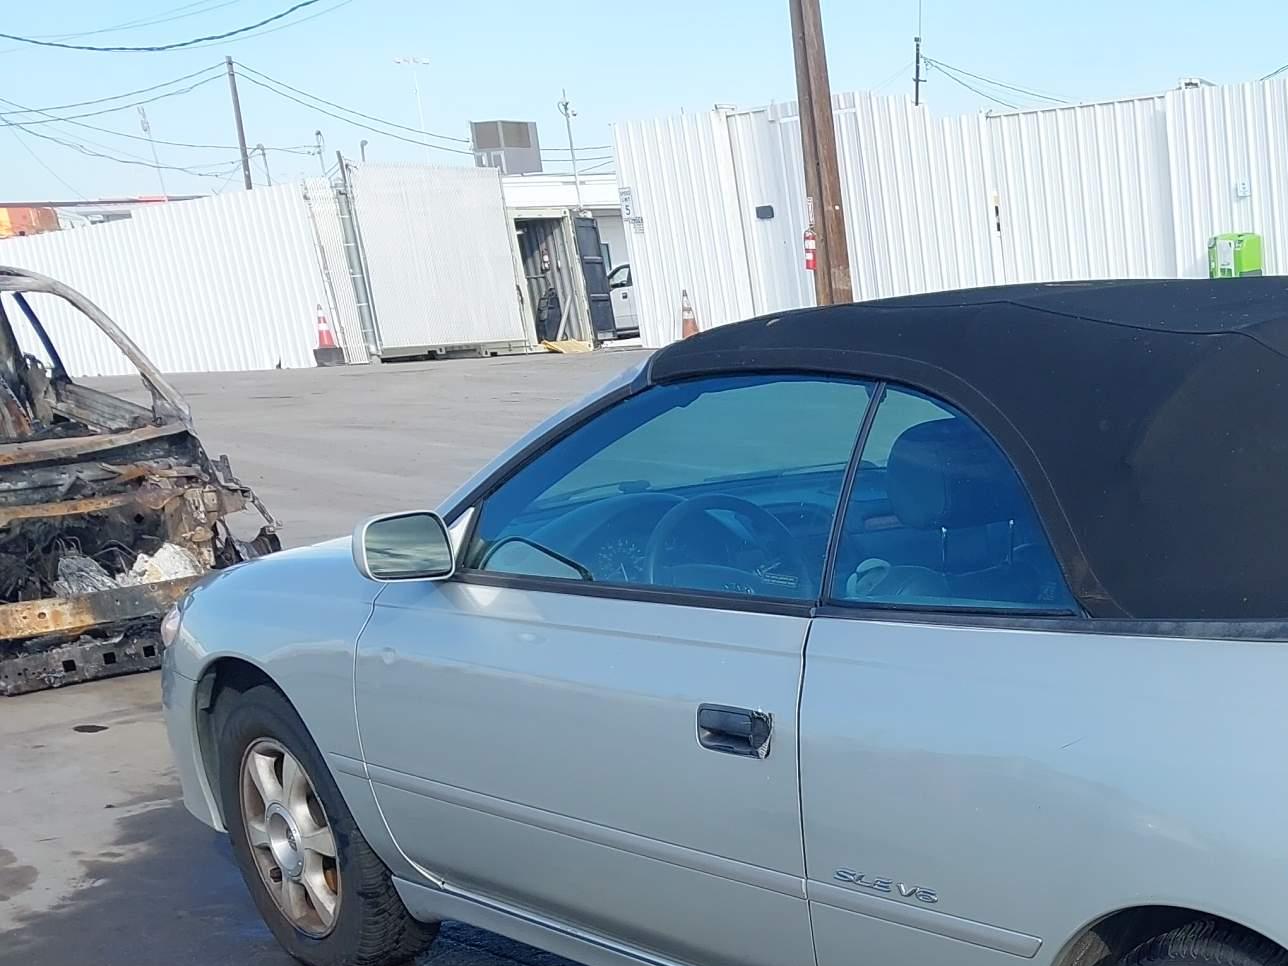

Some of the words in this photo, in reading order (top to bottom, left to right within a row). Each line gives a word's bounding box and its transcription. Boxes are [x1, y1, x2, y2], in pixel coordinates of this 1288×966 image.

[625, 205, 631, 216] 5
[833, 866, 893, 893] SLE
[896, 882, 939, 904] V6
